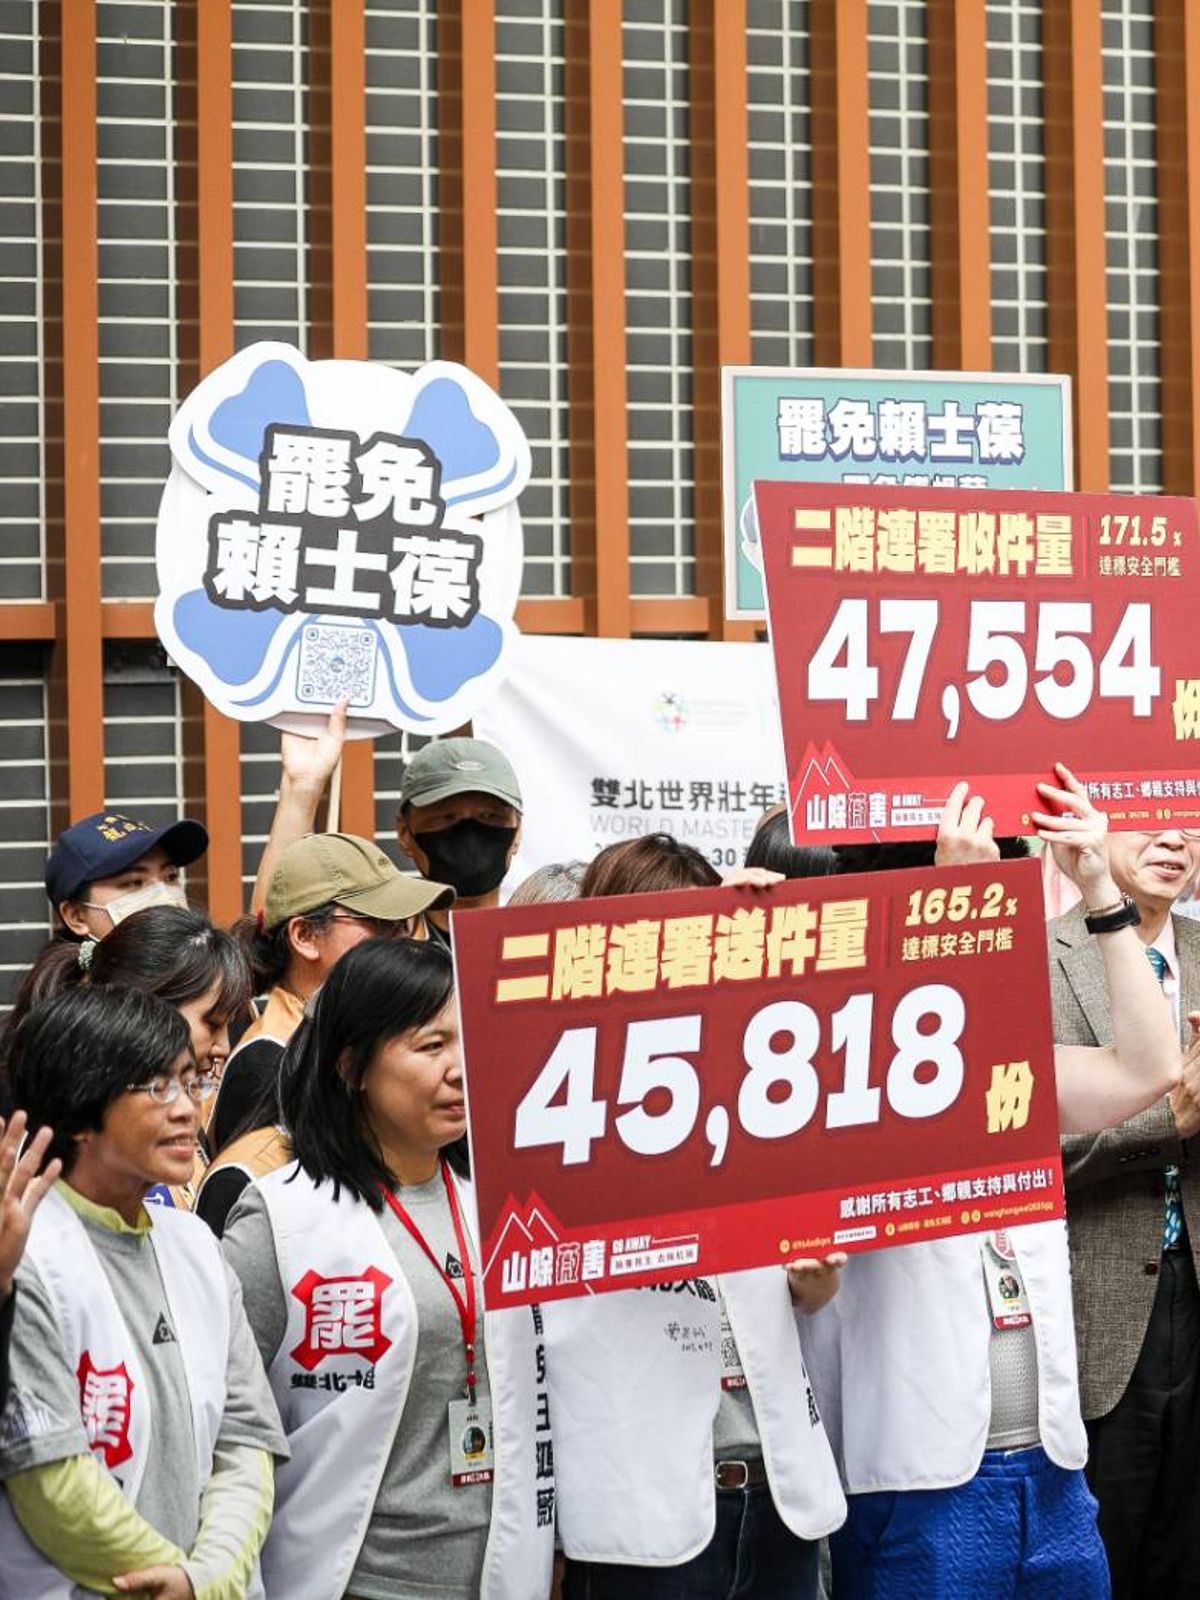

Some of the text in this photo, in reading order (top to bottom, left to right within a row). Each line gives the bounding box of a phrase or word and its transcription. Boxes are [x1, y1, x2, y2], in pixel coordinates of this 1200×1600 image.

[777, 397, 1026, 465] 罷免賴士葆
[266, 430, 440, 527] 罷免
[212, 518, 477, 620] 賴士葆
[791, 507, 1074, 577] 二階連署收件量
[1099, 555, 1182, 577] 達標安全門檻
[806, 598, 1162, 740] 47,554
[589, 814, 756, 841] WORLD MASTE
[904, 882, 1018, 926] 165.2%
[494, 899, 870, 1002] 二階連署送件量
[901, 927, 1013, 963] 達標安全門檻
[513, 984, 1035, 1167] 45,818 份
[839, 1169, 1054, 1220] 感謝所有志工、鄉親支持與付出!
[502, 1239, 606, 1294] 山除薇害
[309, 1281, 376, 1350] 罷
